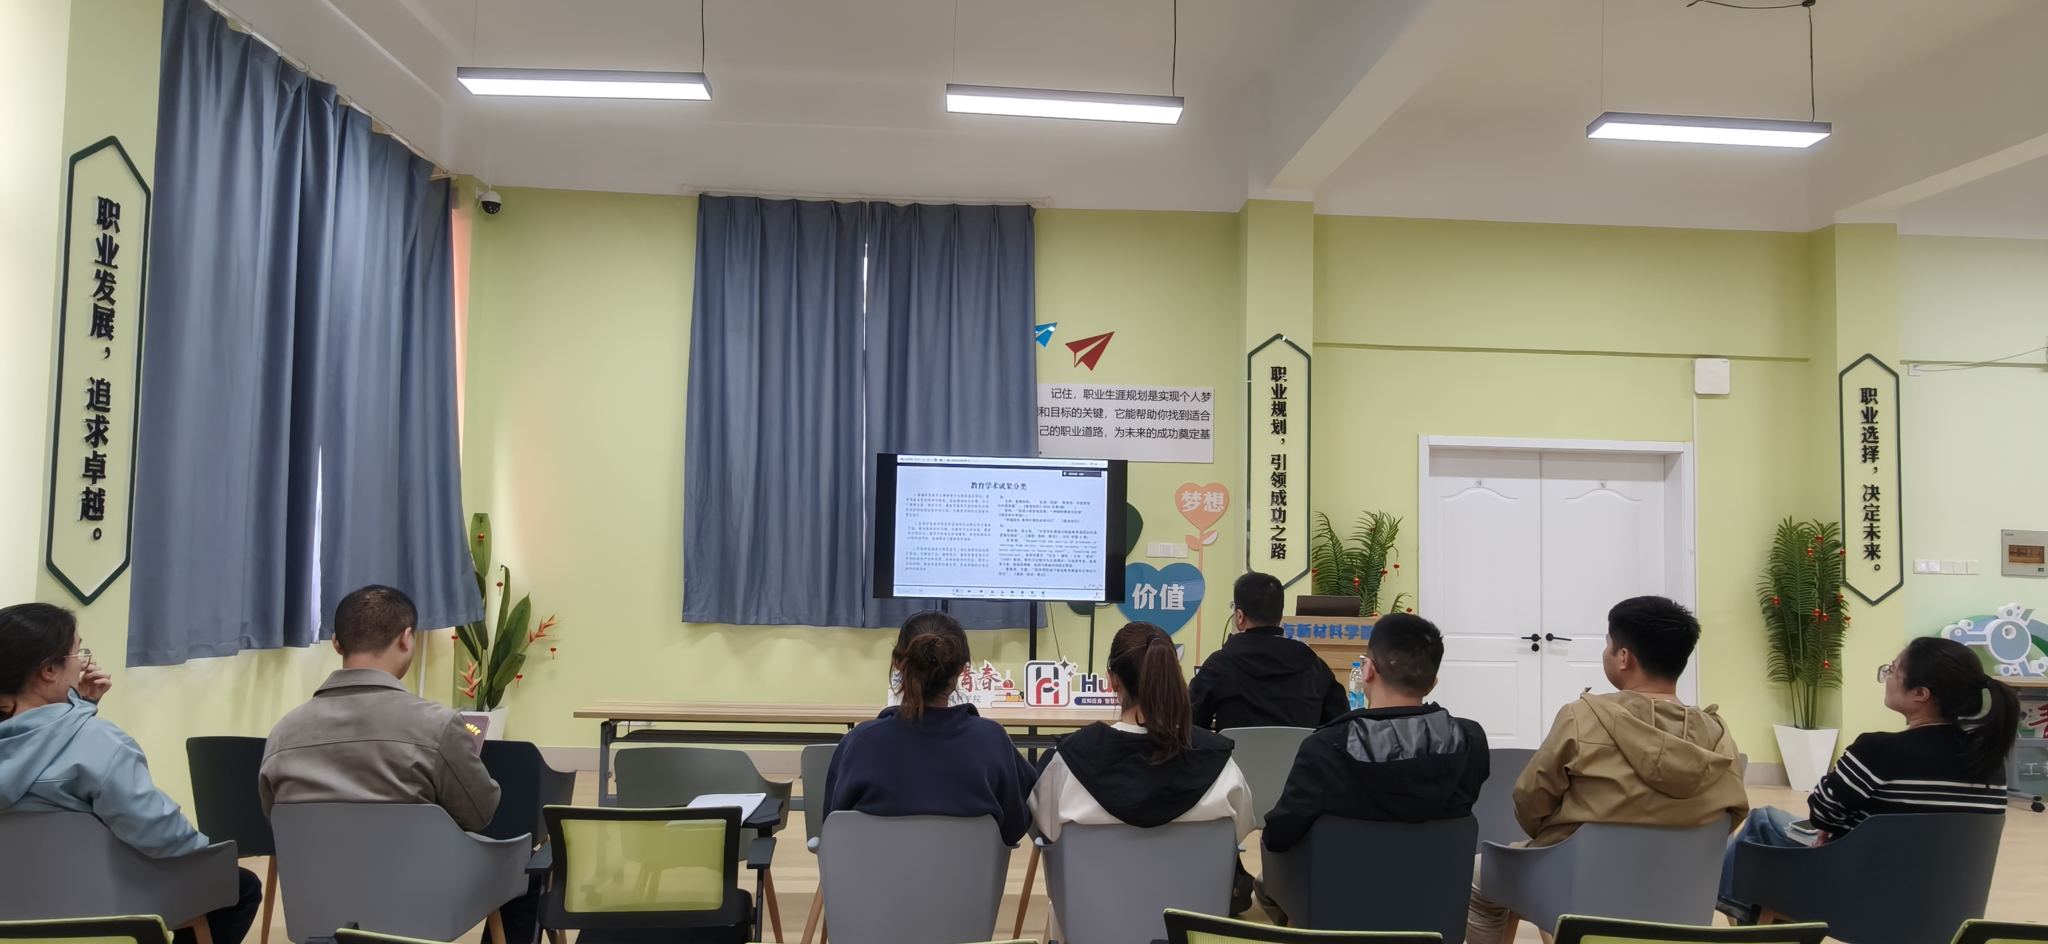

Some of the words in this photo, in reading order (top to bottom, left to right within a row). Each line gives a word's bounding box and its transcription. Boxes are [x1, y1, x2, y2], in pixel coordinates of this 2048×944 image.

[79, 196, 121, 541] 职业发展，追求卓越。
[1050, 387, 1212, 403] 记住，职业生涯规划是实现个人梦
[1037, 406, 1211, 422] 和目标的关键，它能帮助你找到适合
[1039, 426, 1211, 440] 己的职业道路，为未来的成功奠定基
[1270, 366, 1287, 560] 职业规划，引领成功之路
[970, 481, 1027, 491] 教育学术成果分类
[1860, 387, 1881, 571] 职业选择，决定未来。
[1181, 491, 1225, 513] 梦想
[1132, 583, 1186, 611] 价值
